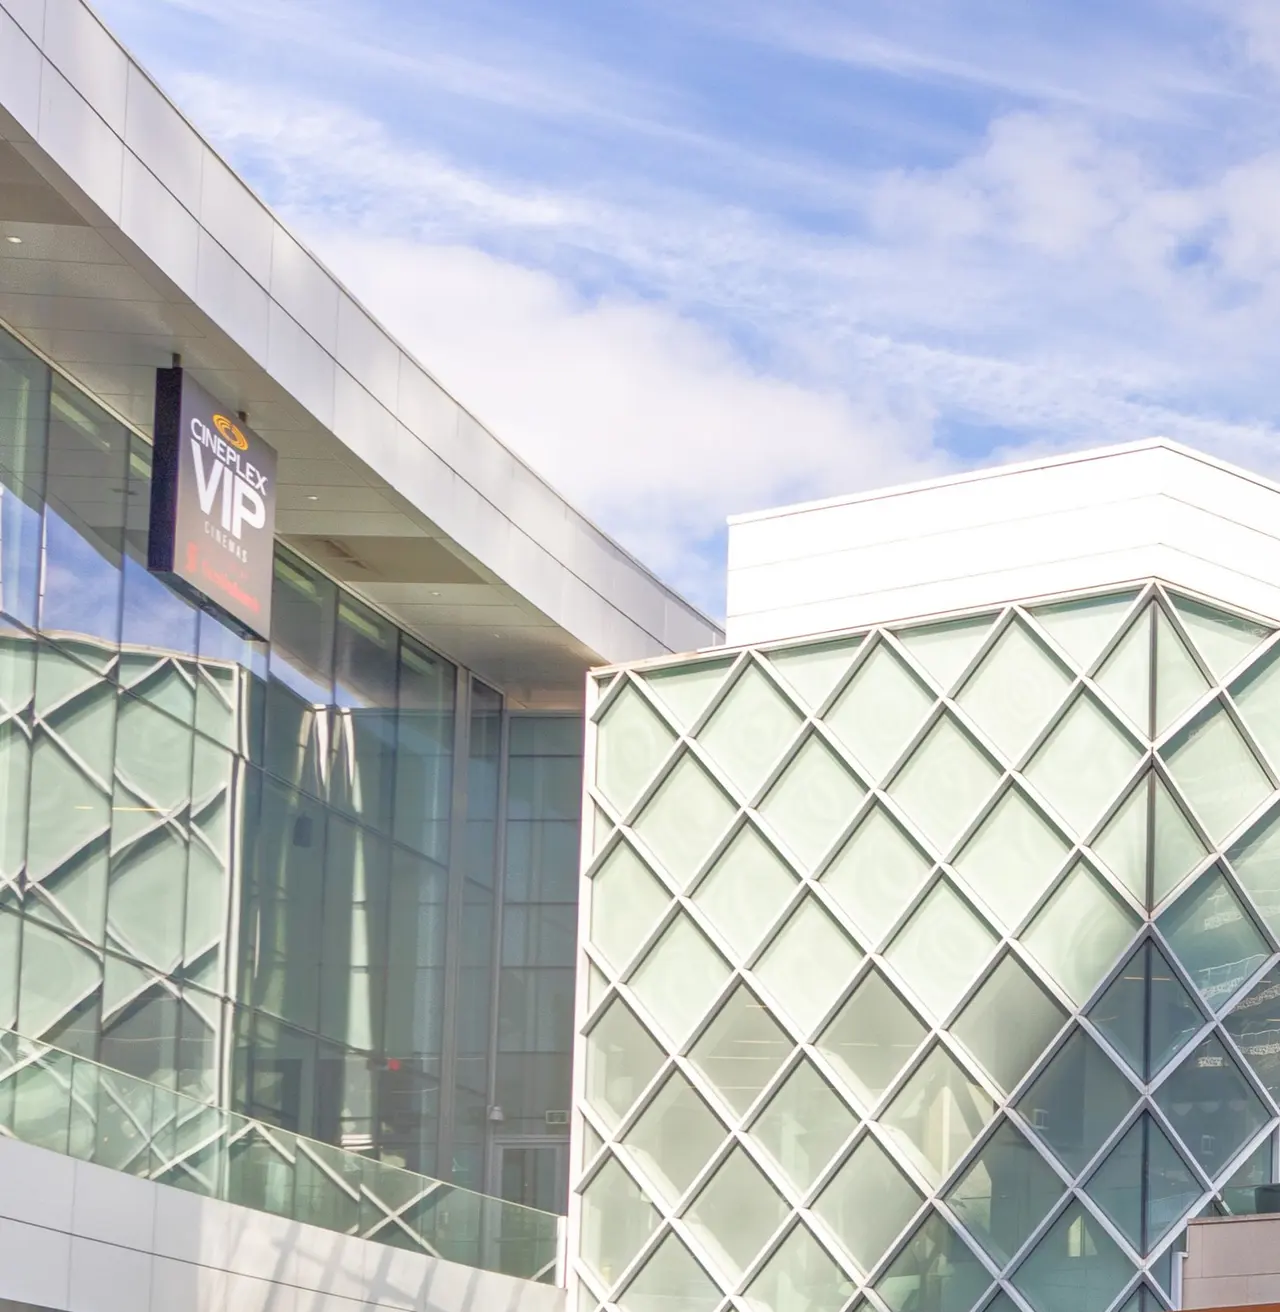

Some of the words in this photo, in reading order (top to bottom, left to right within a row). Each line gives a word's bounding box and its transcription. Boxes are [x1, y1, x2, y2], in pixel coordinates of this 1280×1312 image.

[190, 417, 268, 496] CINEPLEX
[190, 438, 266, 540] VIP
[204, 520, 248, 564] CINEMAS
